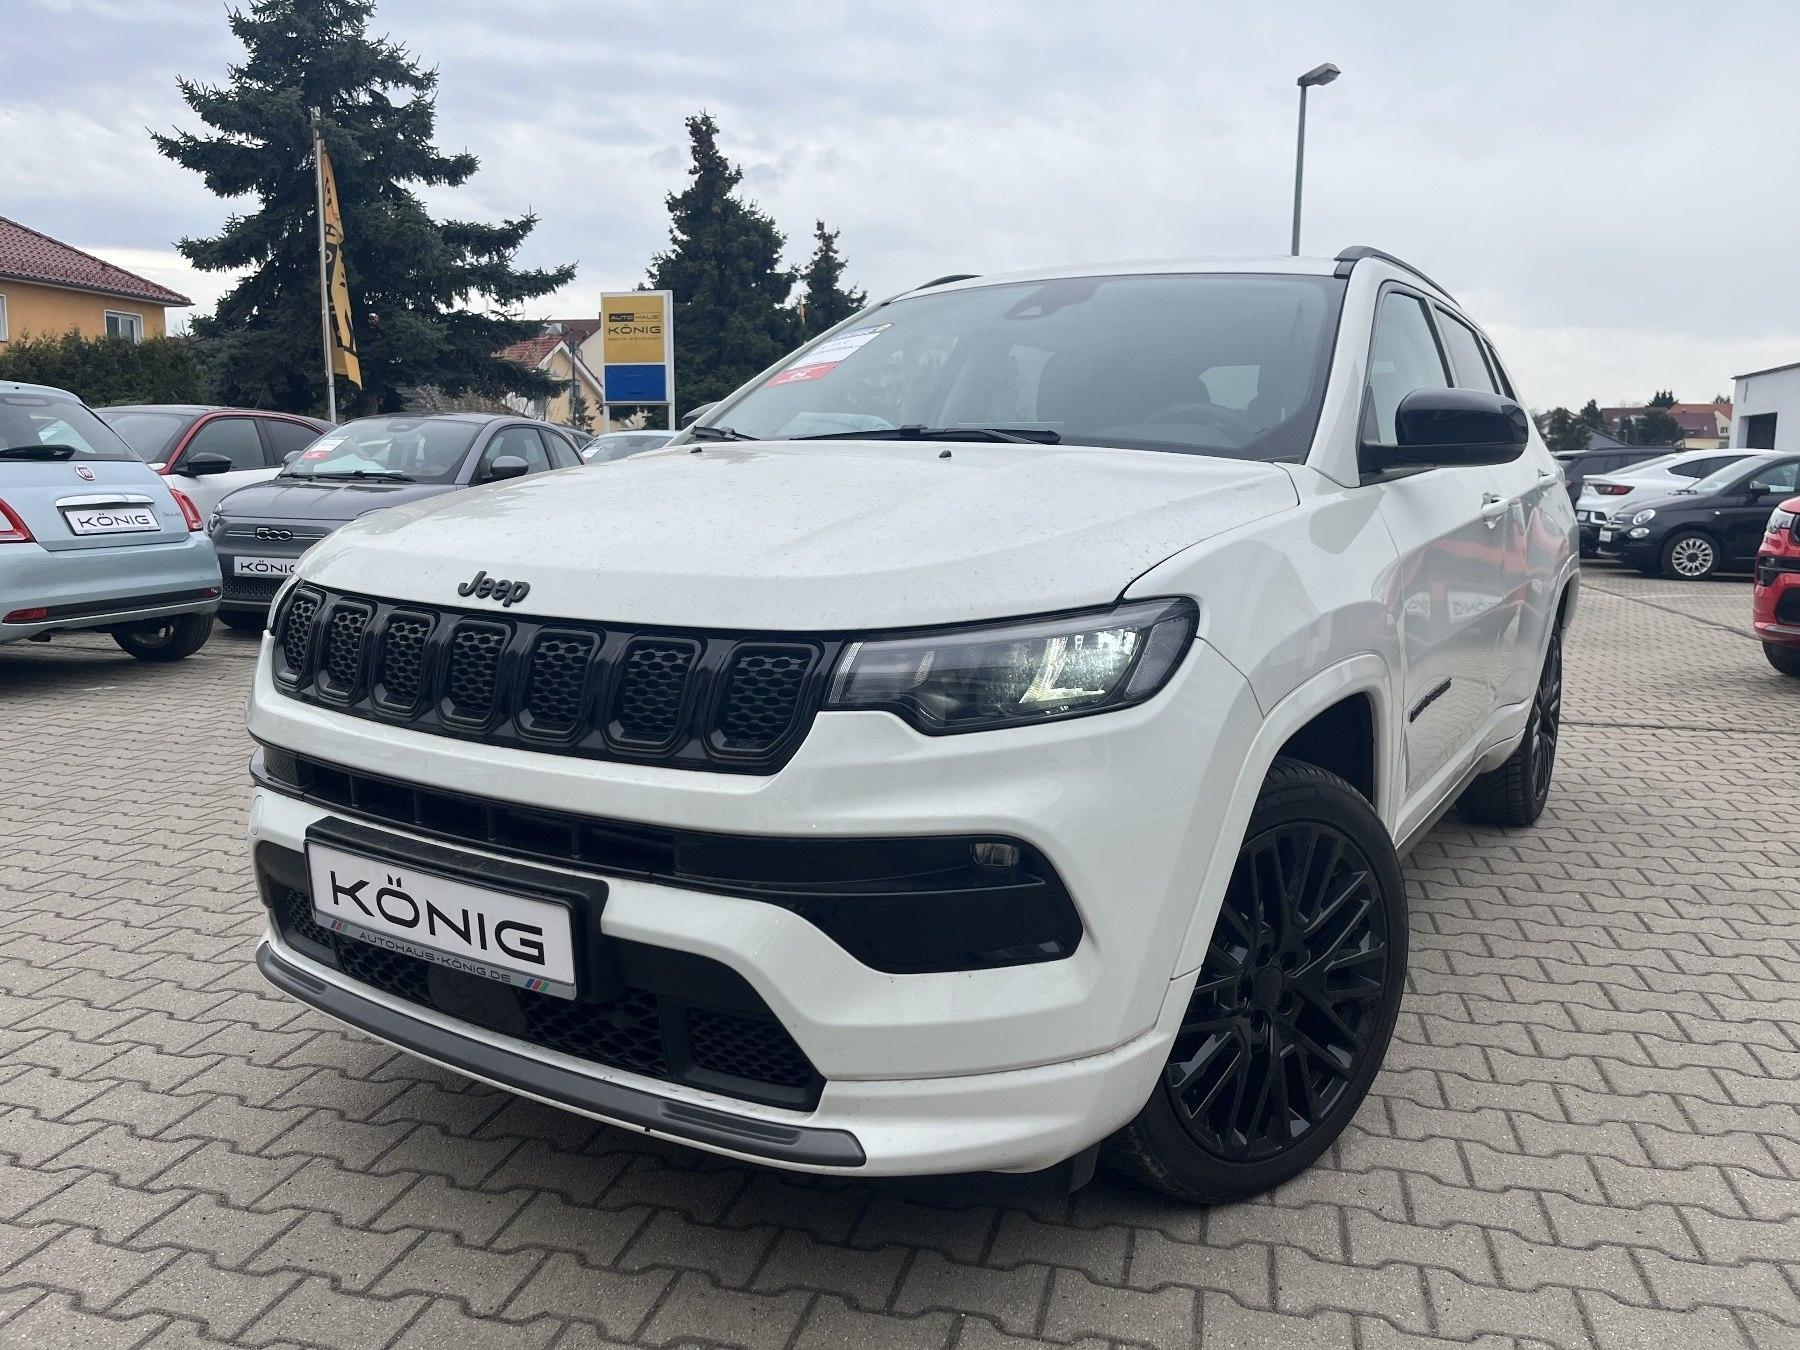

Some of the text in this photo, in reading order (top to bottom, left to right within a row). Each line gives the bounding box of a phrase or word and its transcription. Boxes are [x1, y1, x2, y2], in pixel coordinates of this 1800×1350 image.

[608, 323, 661, 335] KÖNIG
[77, 512, 150, 528] KÖNIG
[256, 526, 293, 541] 500
[457, 570, 531, 608] Jeep
[330, 870, 546, 966] KÖNIG
